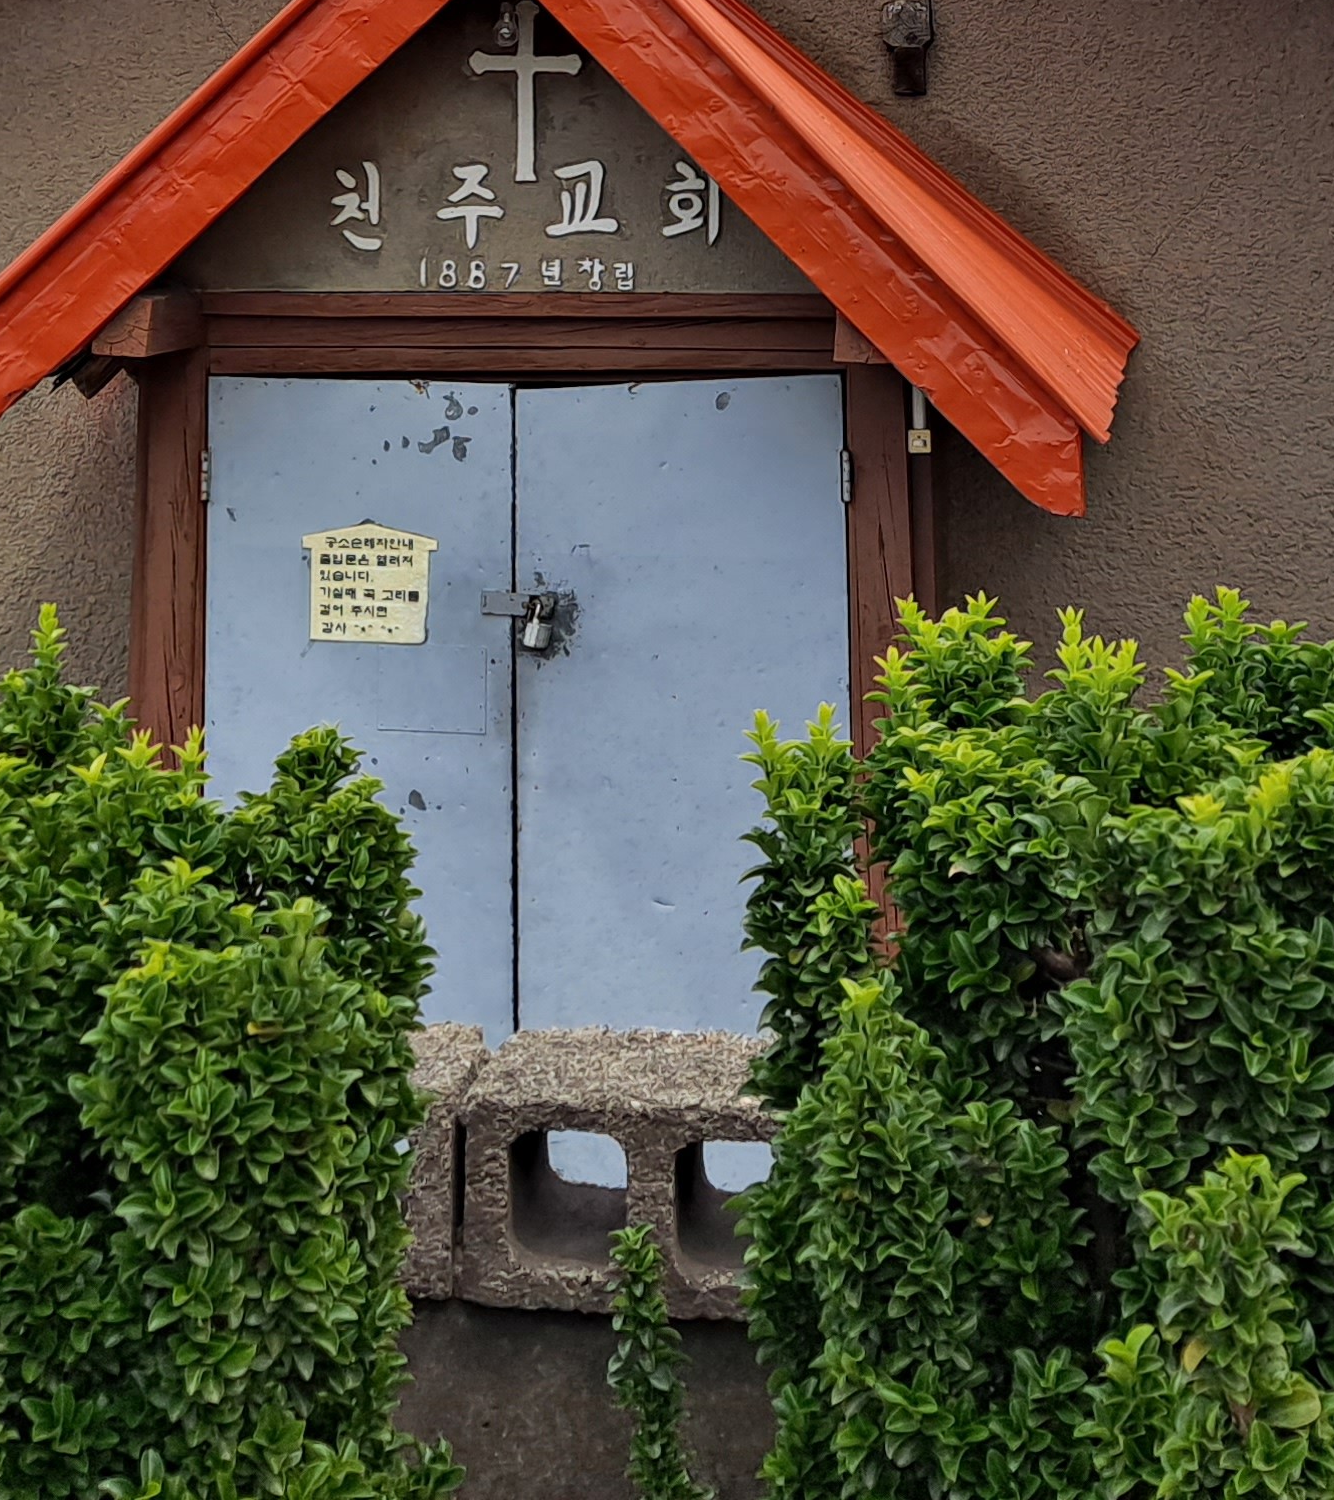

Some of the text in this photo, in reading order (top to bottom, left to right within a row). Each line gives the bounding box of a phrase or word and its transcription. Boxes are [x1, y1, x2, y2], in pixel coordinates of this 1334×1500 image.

[330, 160, 720, 251] 천주교회
[319, 569, 374, 583] 있습니다.
[319, 604, 388, 618] 걸어 주시면
[321, 622, 347, 635] 감사
